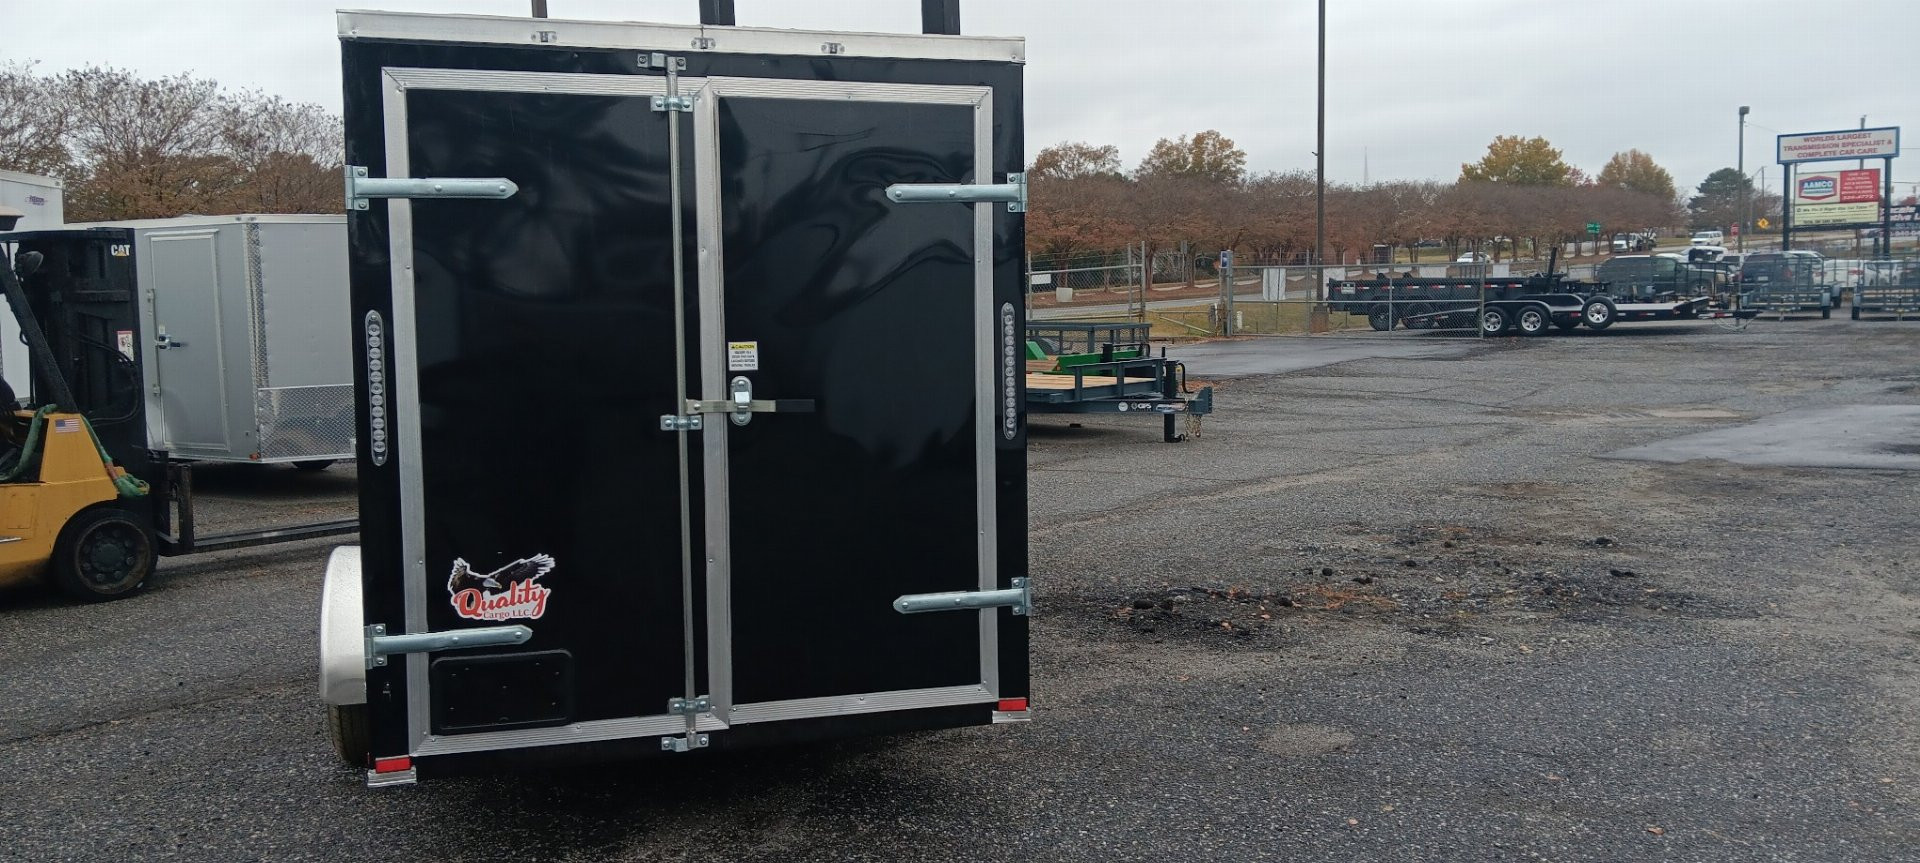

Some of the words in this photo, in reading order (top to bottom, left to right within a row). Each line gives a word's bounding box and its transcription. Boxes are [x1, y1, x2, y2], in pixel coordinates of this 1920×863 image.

[1803, 135, 1836, 143] WORLDS
[1837, 133, 1872, 141] LARGEST
[1784, 143, 1840, 152] TRANSMISSION
[1841, 140, 1885, 148] SPECIALIST
[1797, 151, 1837, 159] COMPLETE
[1804, 181, 1833, 189] AAMCO
[111, 244, 131, 257] CAT
[453, 578, 547, 617] Quality
